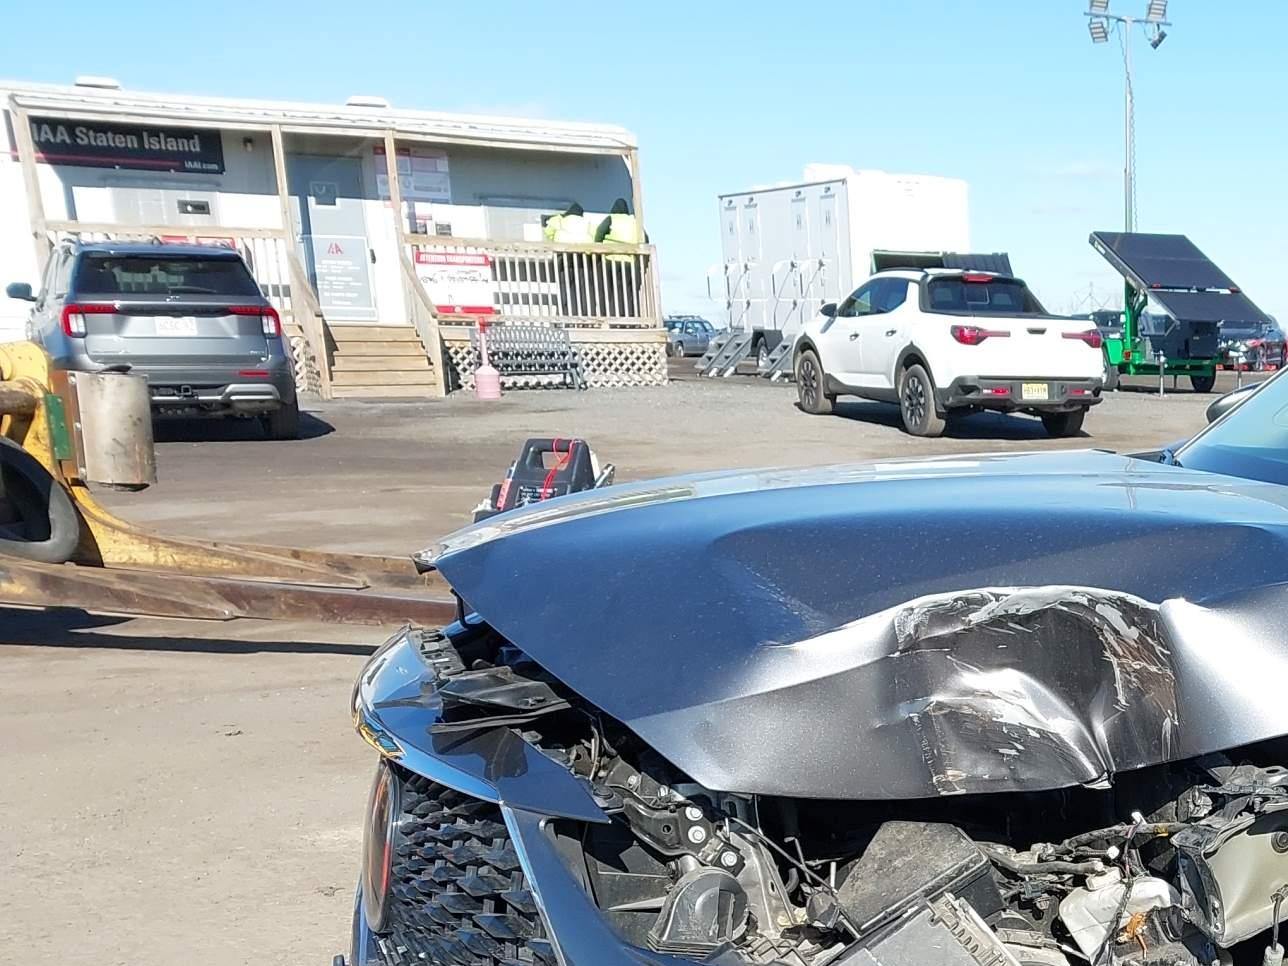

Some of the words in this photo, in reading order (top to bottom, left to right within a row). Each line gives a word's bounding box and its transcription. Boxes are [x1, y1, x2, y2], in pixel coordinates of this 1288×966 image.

[32, 123, 71, 145] IAA
[76, 126, 139, 149] Staten
[143, 131, 201, 152] Island
